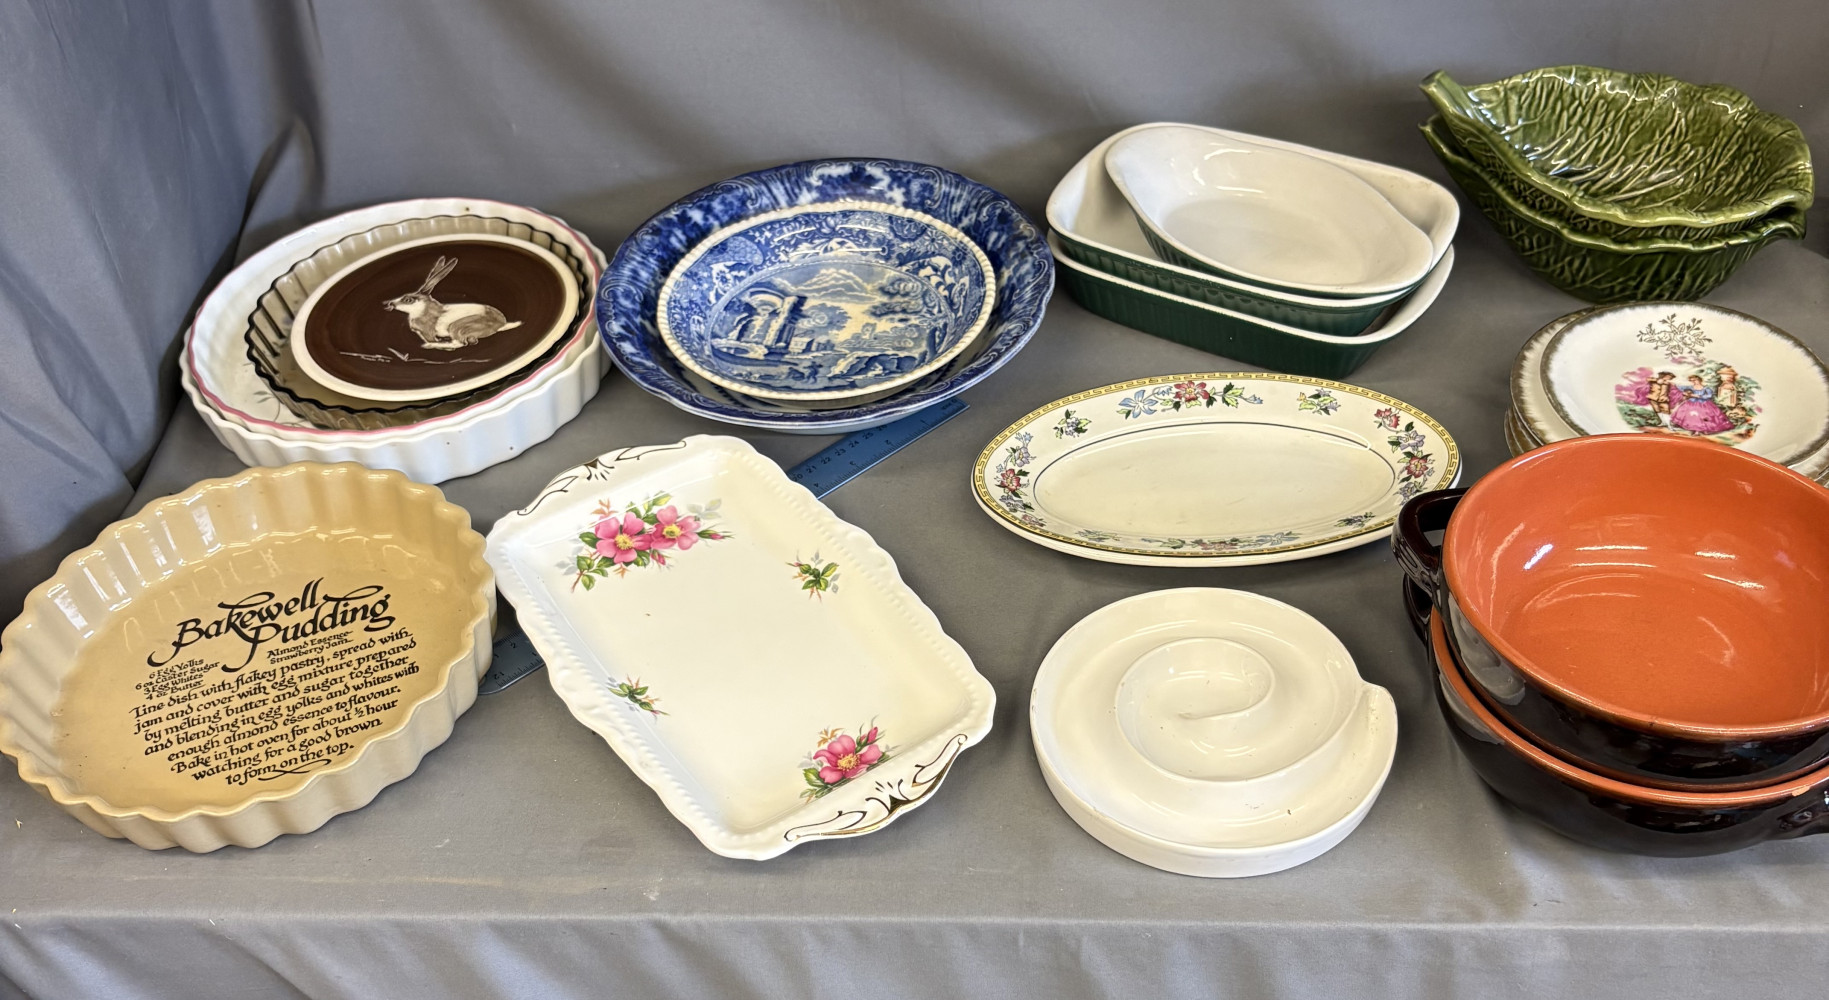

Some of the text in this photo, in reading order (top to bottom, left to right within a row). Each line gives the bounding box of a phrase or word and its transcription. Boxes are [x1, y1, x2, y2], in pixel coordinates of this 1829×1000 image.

[147, 577, 324, 667] Bakewell
[221, 585, 396, 673] Pudding
[267, 631, 354, 658] Almond Essence
[270, 638, 354, 664] Strawberry Jam
[129, 702, 165, 719] Line
[167, 684, 206, 707] dish
[200, 679, 235, 697] with
[232, 666, 277, 693] flakey
[332, 638, 376, 660] spread
[378, 627, 413, 645] with
[134, 637, 417, 735] jam and cover with egg mixture prepared
[135, 682, 142, 690] 6
[155, 670, 188, 684] Caster
[189, 661, 220, 673] Sugar
[144, 655, 409, 743] by melting butter and sugar together
[149, 658, 204, 679] 6 Egg Yolks
[151, 682, 171, 693] Egg
[171, 672, 204, 686] Whites
[170, 680, 204, 693] Butter
[144, 661, 420, 756] and blending in egg yolks and whites with
[167, 734, 221, 762] enough
[223, 719, 279, 745] almond
[282, 705, 334, 726] essence
[345, 685, 401, 712] flavour.
[170, 755, 212, 774] Bake
[214, 750, 229, 761] in
[226, 742, 255, 757] hot
[257, 732, 290, 748] oven
[288, 725, 310, 743] for
[312, 712, 353, 732] about
[364, 699, 399, 715] hour
[192, 718, 383, 781] watching for a good brown
[225, 741, 355, 786] to form on the top.
